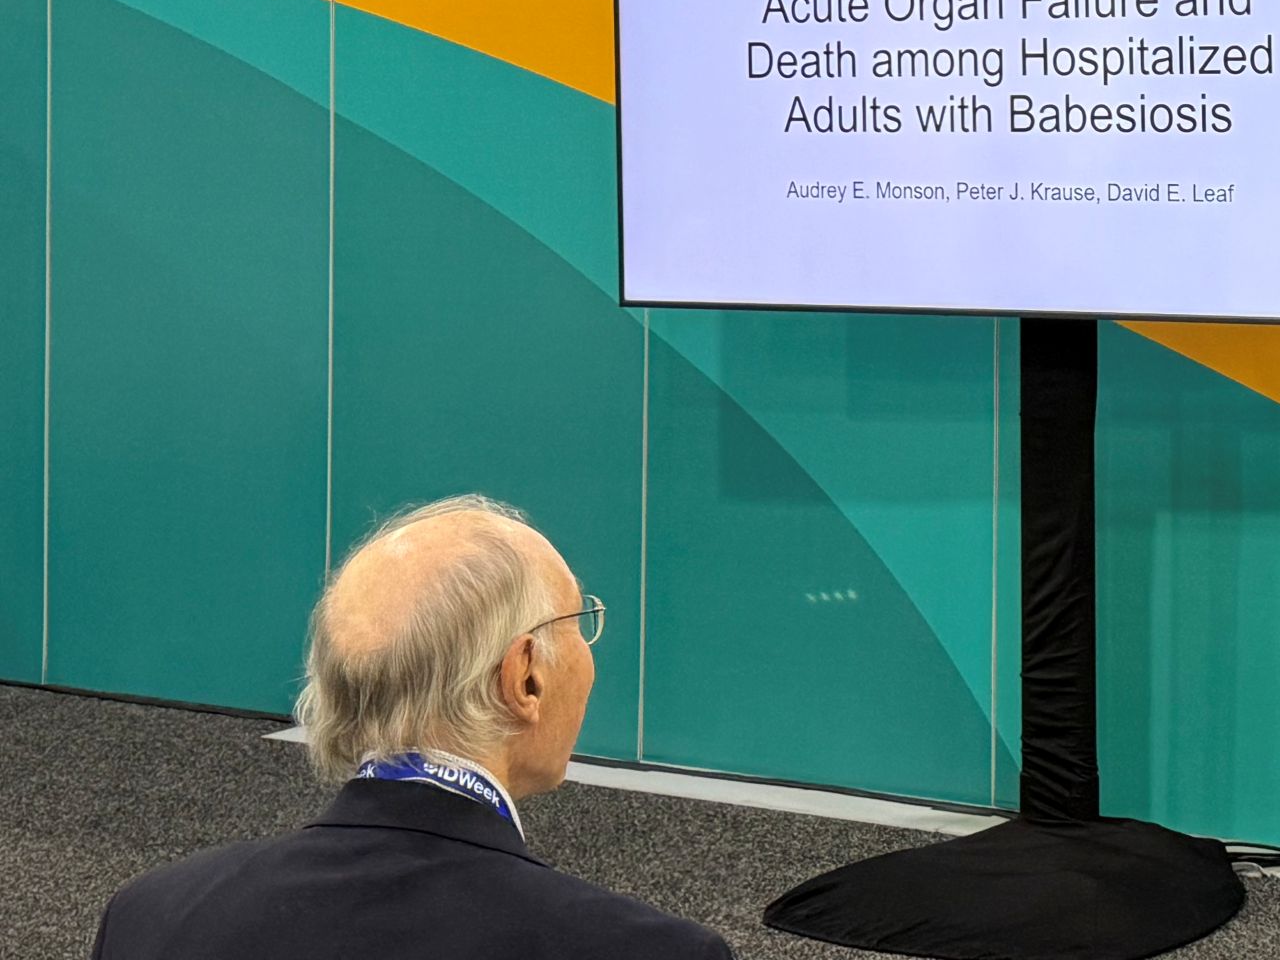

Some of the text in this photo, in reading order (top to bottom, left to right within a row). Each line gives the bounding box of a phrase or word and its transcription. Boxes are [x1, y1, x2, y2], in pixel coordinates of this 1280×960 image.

[747, 34, 1274, 87] Death among Hospitalized
[784, 93, 1233, 134] Adults with Babesiosis
[786, 180, 1236, 204] Audrey E. Monson, Peter J. Krause, David E. Leaf
